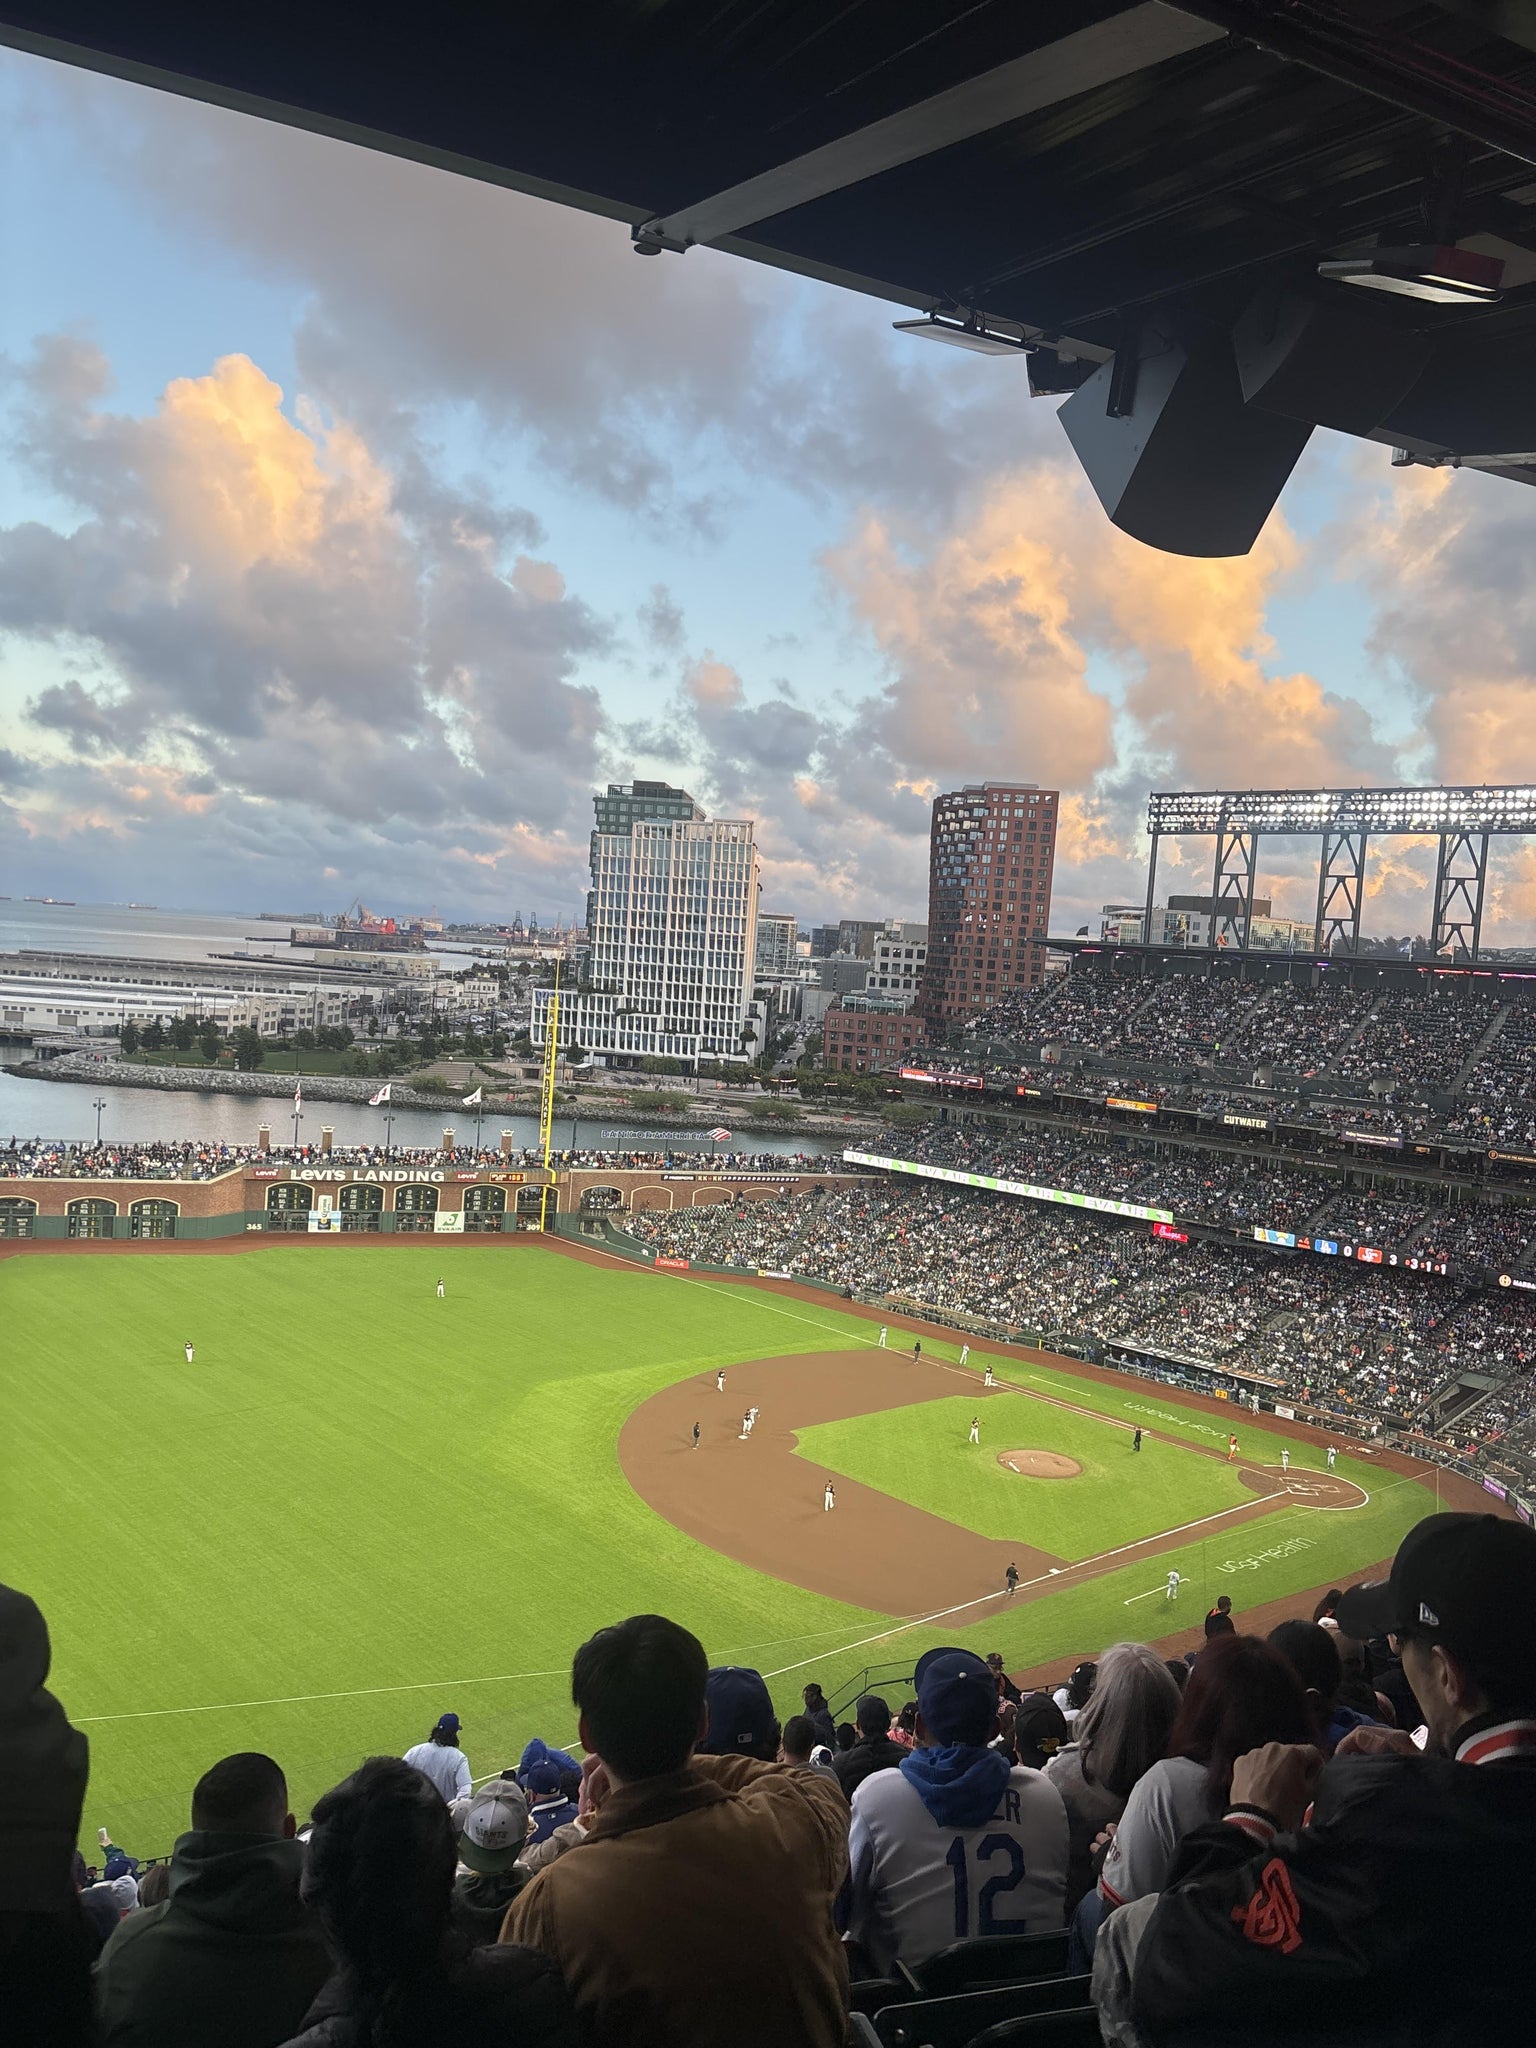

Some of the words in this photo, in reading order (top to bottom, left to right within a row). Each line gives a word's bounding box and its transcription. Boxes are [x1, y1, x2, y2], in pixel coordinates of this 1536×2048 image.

[1224, 1115, 1266, 1128] CUTWATER
[353, 1170, 444, 1182] LANDING
[1343, 1246, 1352, 1257] 0
[1389, 1254, 1398, 1266] 3
[1410, 1258, 1418, 1270] 3
[1426, 1261, 1432, 1272] 1
[1441, 1264, 1446, 1275] 1
[1216, 1558, 1260, 1573] UCSF
[1249, 1537, 1317, 1562] Health
[946, 1833, 1026, 1938] 12
